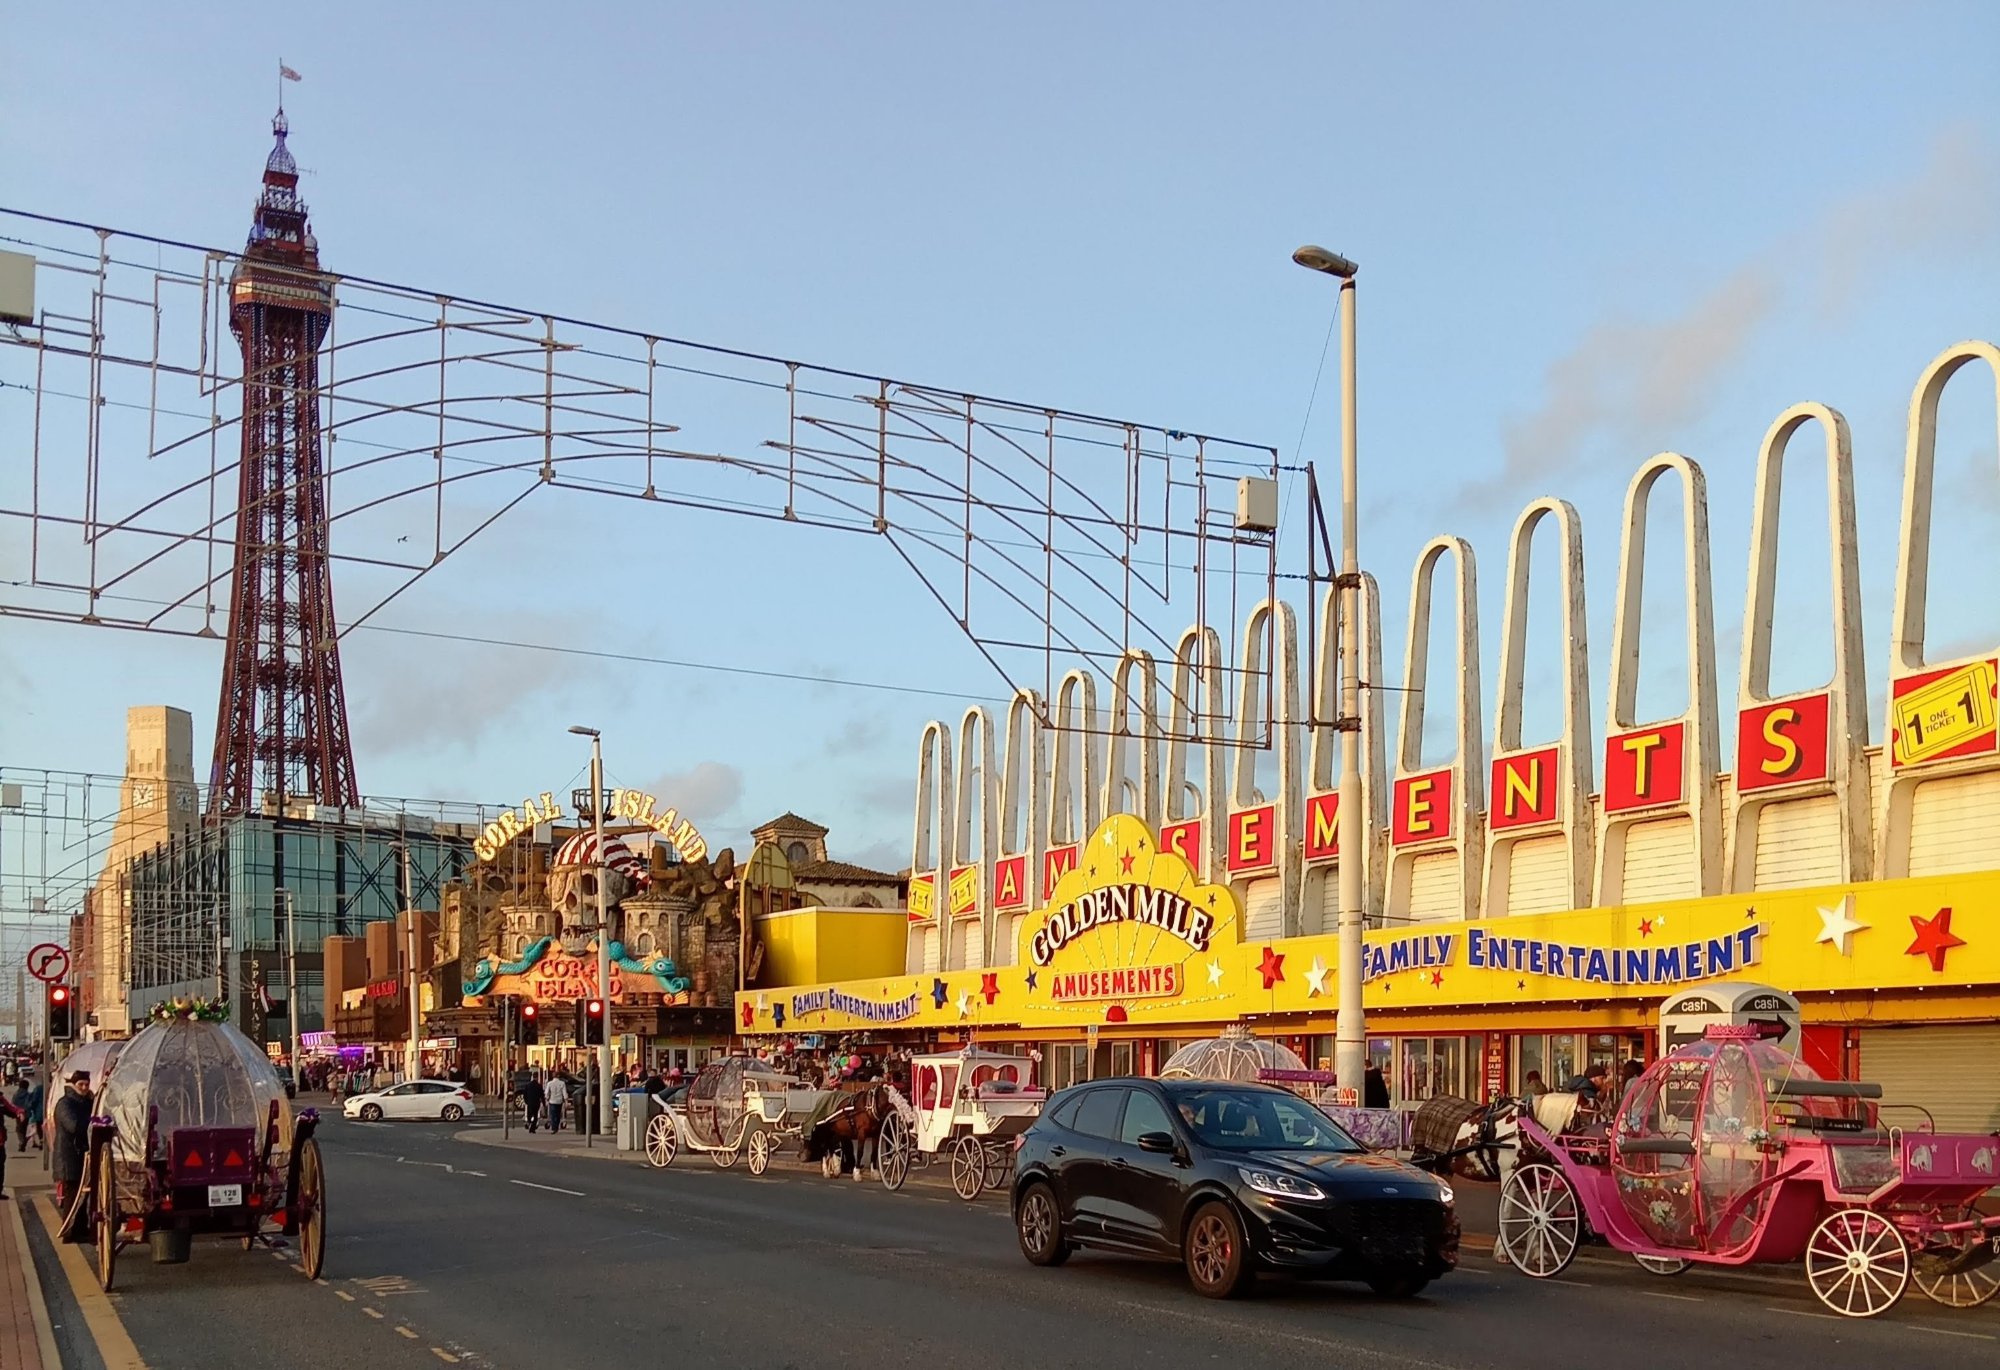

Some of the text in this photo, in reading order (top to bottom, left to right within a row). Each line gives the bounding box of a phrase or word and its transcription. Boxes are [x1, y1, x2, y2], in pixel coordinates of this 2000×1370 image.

[1929, 707, 1949, 723] ONE
[1957, 691, 1975, 724] 1
[1907, 713, 1924, 746] 1
[1925, 715, 1956, 734] TICKET
[473, 788, 708, 864] CORAL ISLAND
[1031, 884, 1212, 966] GOLDEN MILE
[1362, 923, 1762, 985] FAMILY ENTERTAINMENT
[1052, 967, 1174, 999] AMUSEMENTS
[793, 988, 917, 1021] FAMILY ENTERTAINMENT
[1681, 1000, 1707, 1012] cash
[1754, 997, 1779, 1010] cash
